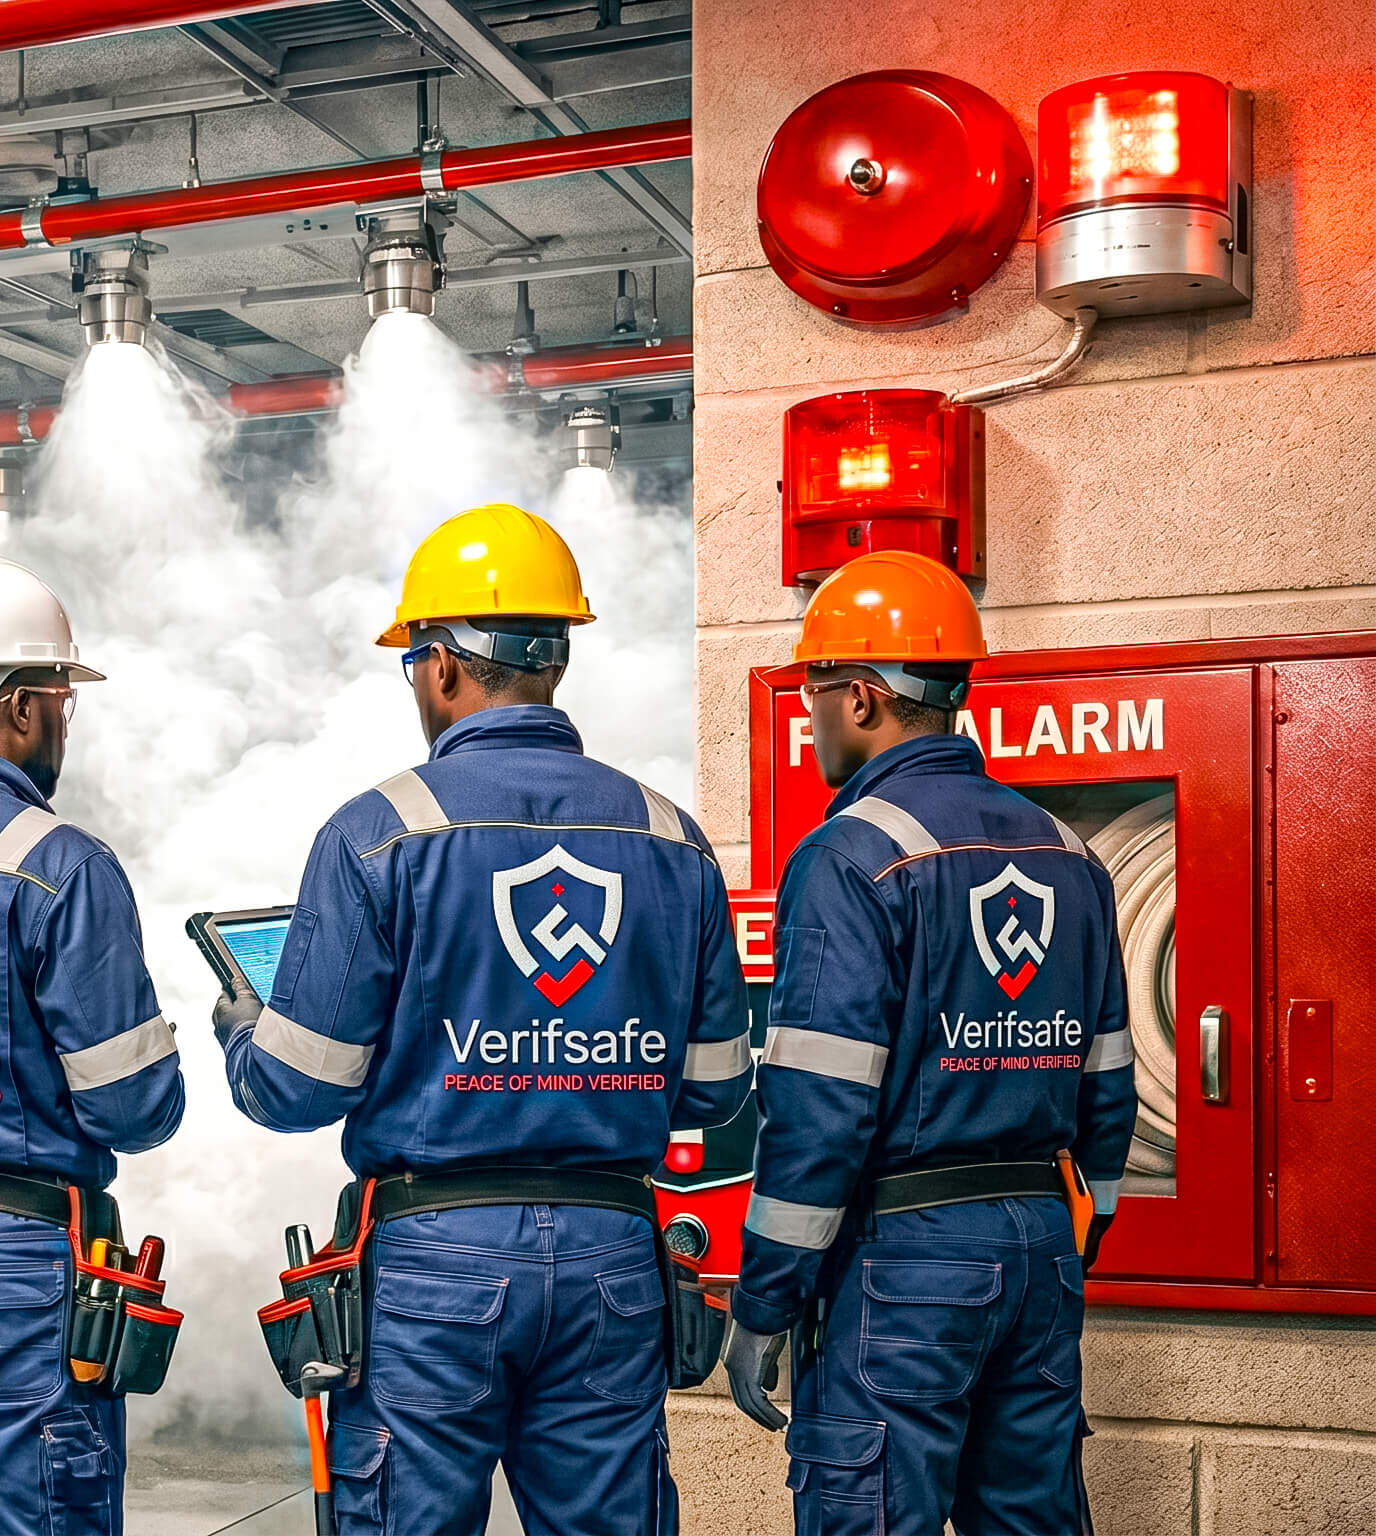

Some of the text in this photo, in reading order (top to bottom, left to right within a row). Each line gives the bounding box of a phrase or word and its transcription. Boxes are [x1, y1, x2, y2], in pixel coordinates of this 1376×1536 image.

[955, 698, 1164, 759] ALARM
[442, 1017, 667, 1064] Verifsafe
[940, 1009, 1082, 1049] Verifsafe
[444, 1074, 665, 1091] PEACE OF MIND VERIFIED
[940, 1054, 1081, 1072] PEACE OF MIND VERIFIED
